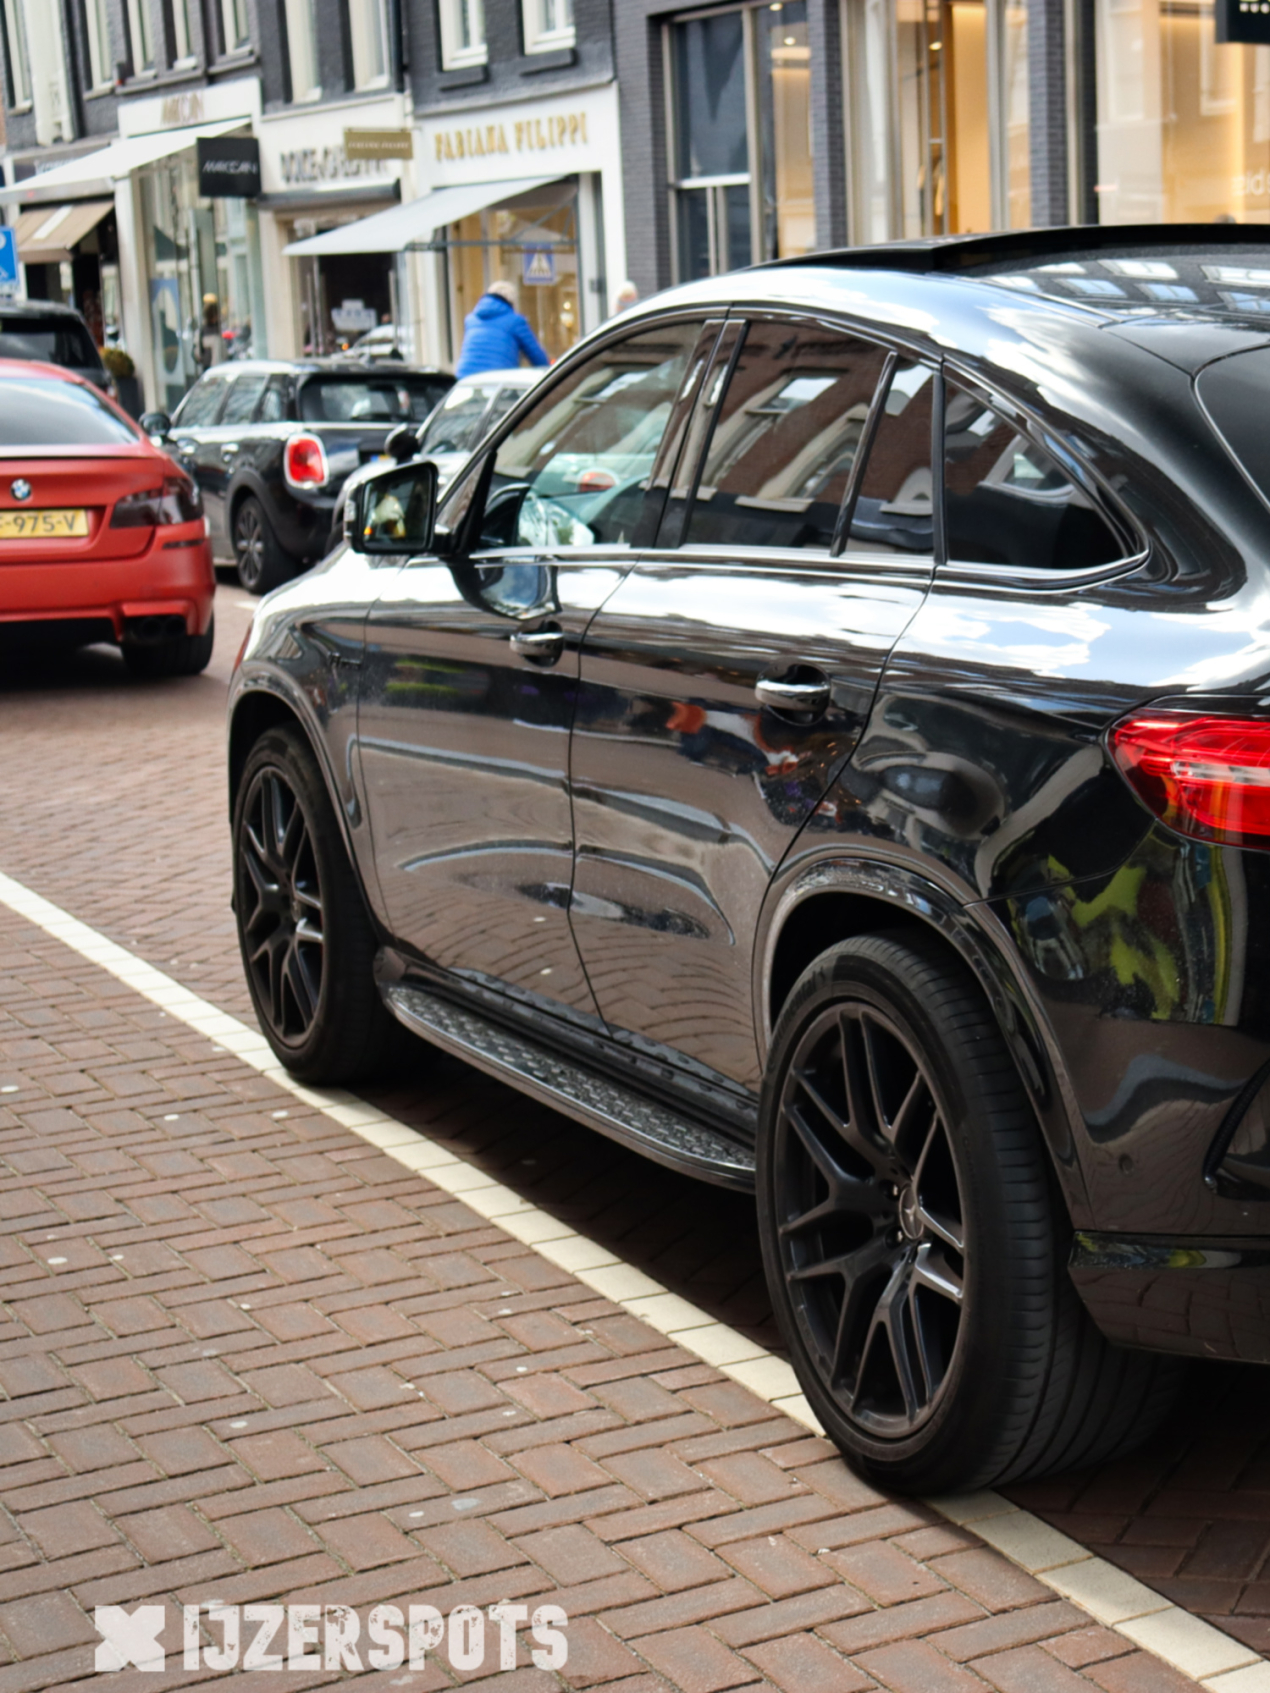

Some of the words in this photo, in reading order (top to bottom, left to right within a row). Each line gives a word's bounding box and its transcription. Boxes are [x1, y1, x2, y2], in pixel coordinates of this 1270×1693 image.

[434, 125, 509, 162] FABIANA
[515, 112, 587, 152] FILIPPI
[0, 513, 76, 534] -975-V
